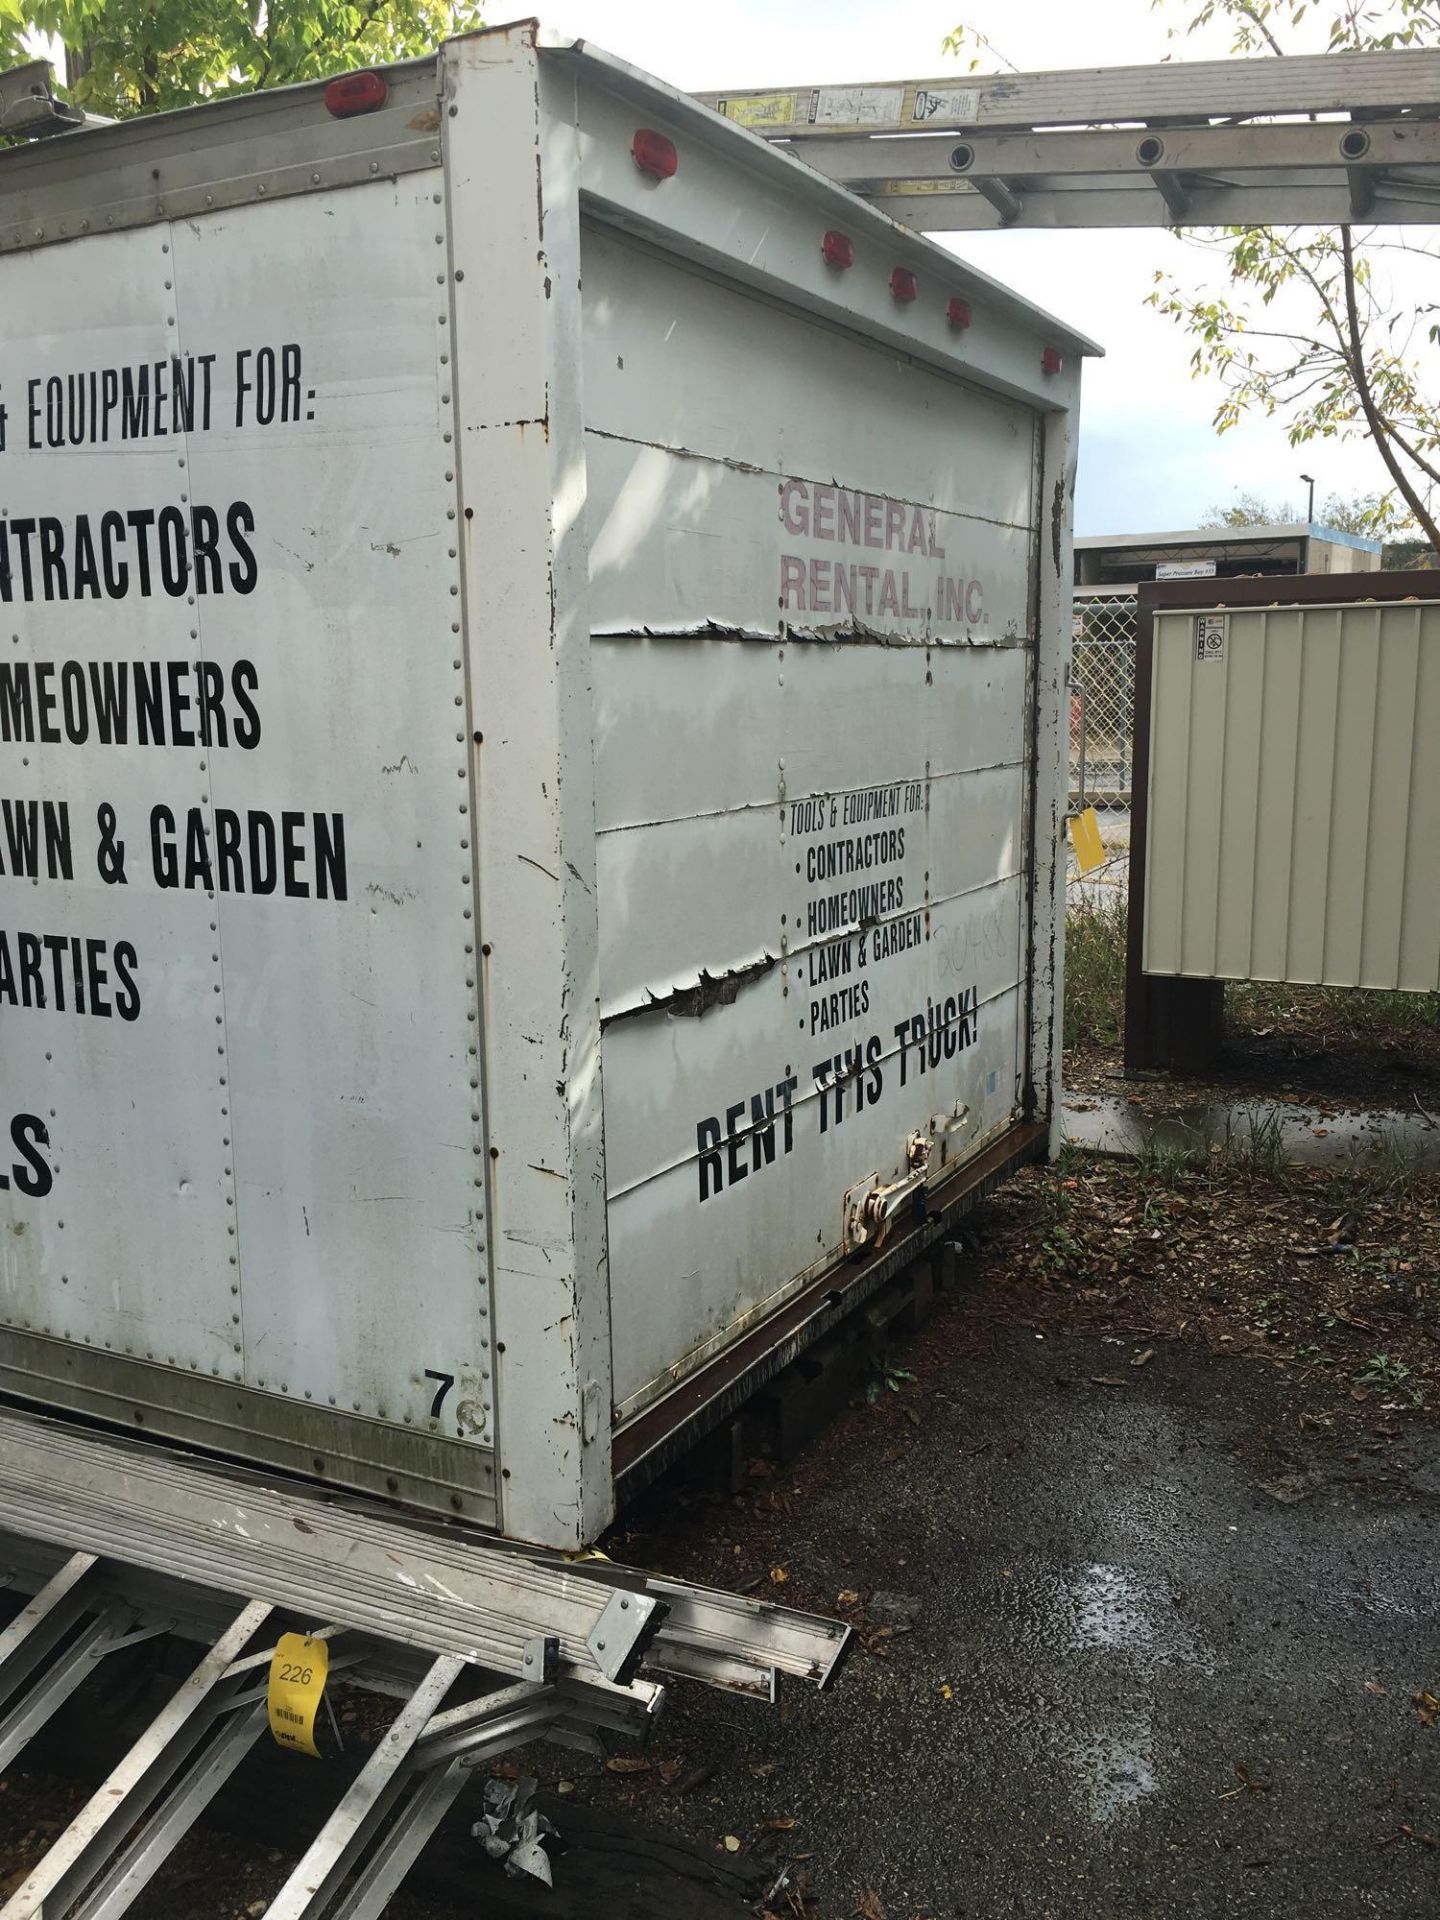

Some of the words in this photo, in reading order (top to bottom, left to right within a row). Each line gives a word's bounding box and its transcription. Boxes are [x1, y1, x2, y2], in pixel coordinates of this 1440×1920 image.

[28, 354, 216, 449] EQUIPMENT
[236, 343, 316, 427] FOR:
[781, 478, 945, 559] GENERAL
[781, 555, 927, 627] RENTAL,
[937, 576, 989, 625] INC.
[791, 799, 825, 835] TOOLS
[830, 798, 837, 828] &
[843, 787, 902, 825] EQUIPMENT
[904, 784, 924, 815] FOR:
[97, 802, 128, 885] &
[150, 804, 348, 901] GARDEN
[807, 827, 905, 883] CONTRACTORS
[807, 876, 903, 937] HOMEOWNERS
[809, 940, 851, 987] LAWN
[858, 932, 867, 968] &
[873, 915, 922, 961] GARDEN
[810, 980, 869, 1036] PARTIES
[697, 1075, 798, 1203] RENT
[812, 1035, 883, 1134] THIS
[894, 985, 978, 1087] TRUCK!
[424, 1369, 454, 1418] 7
[279, 1663, 313, 1685] 226
